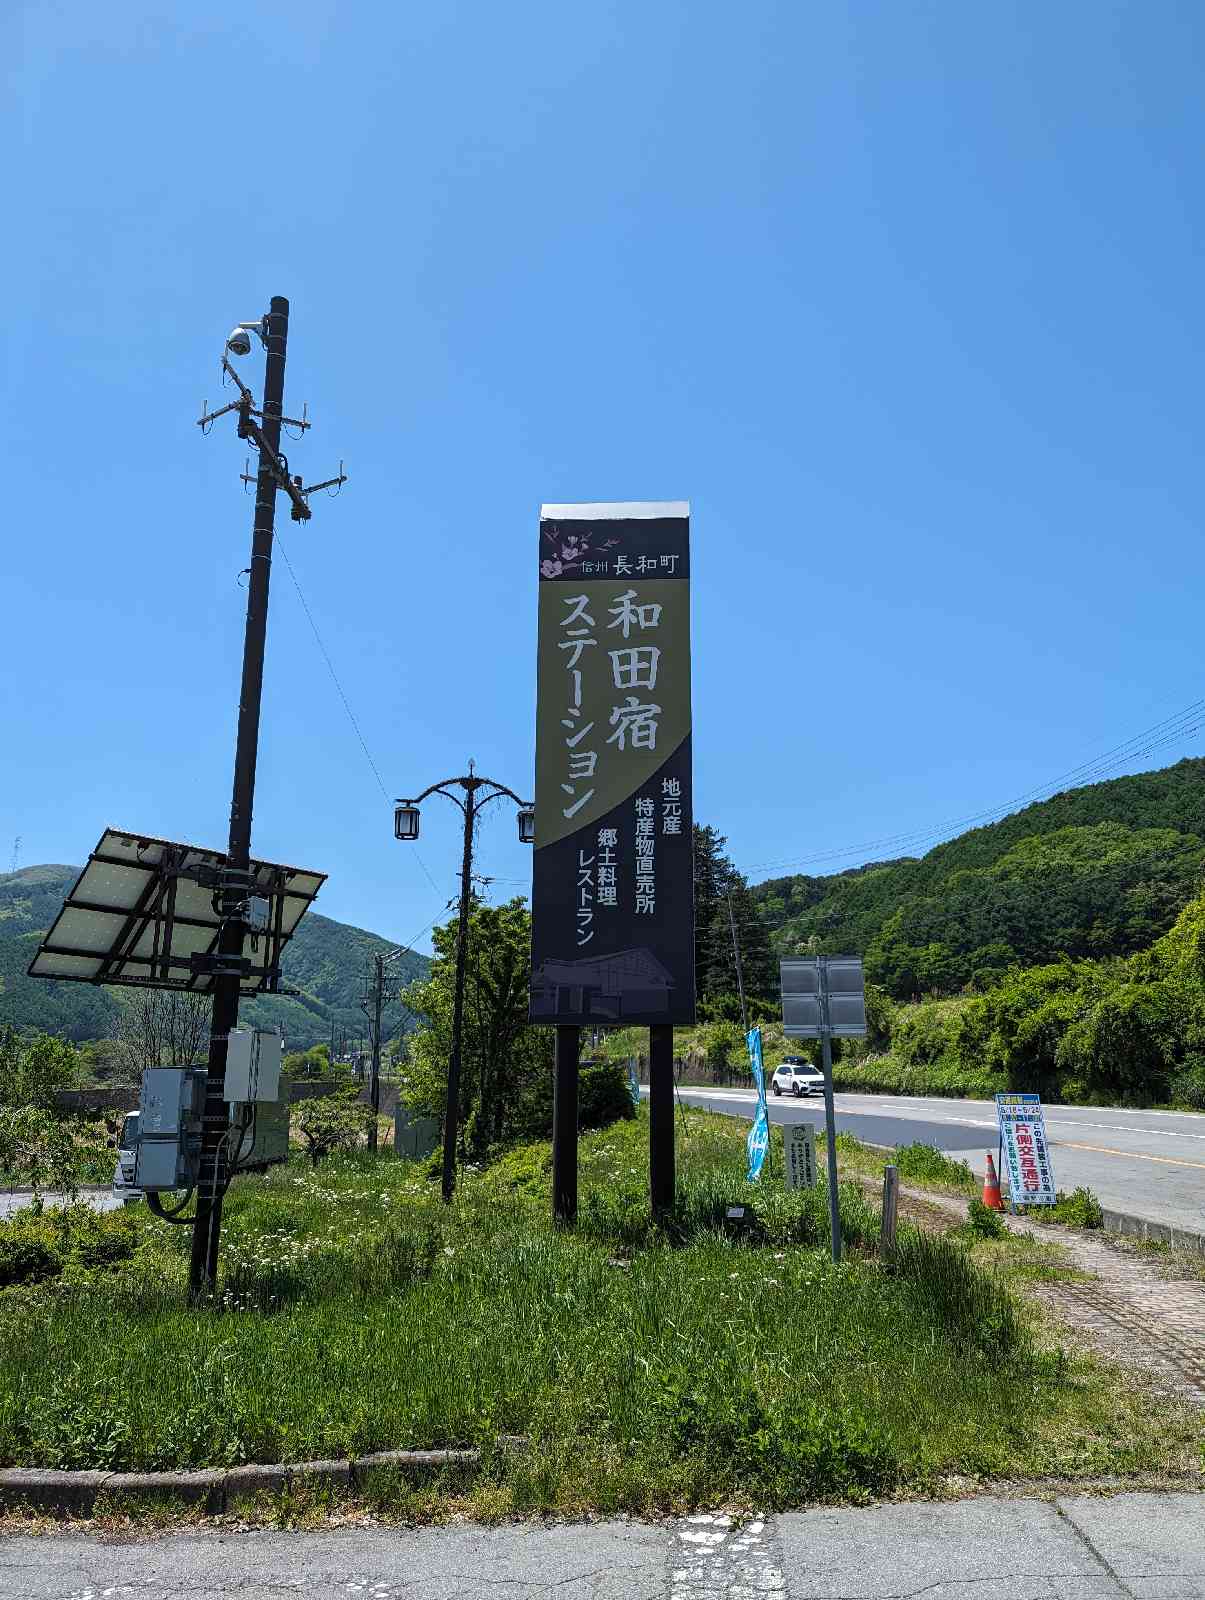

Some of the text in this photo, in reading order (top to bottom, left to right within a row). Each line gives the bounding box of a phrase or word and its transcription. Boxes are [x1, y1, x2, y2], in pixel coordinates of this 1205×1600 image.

[582, 554, 679, 576] 信州 長和町
[557, 594, 598, 819] ステーション
[606, 589, 664, 751] 和田宿
[661, 777, 683, 836] 地元産
[576, 849, 596, 946] レストラン
[597, 828, 618, 907] 郷土料理
[634, 797, 657, 915] 特産物直売所
[1015, 1123, 1041, 1192] 片側交互通行
